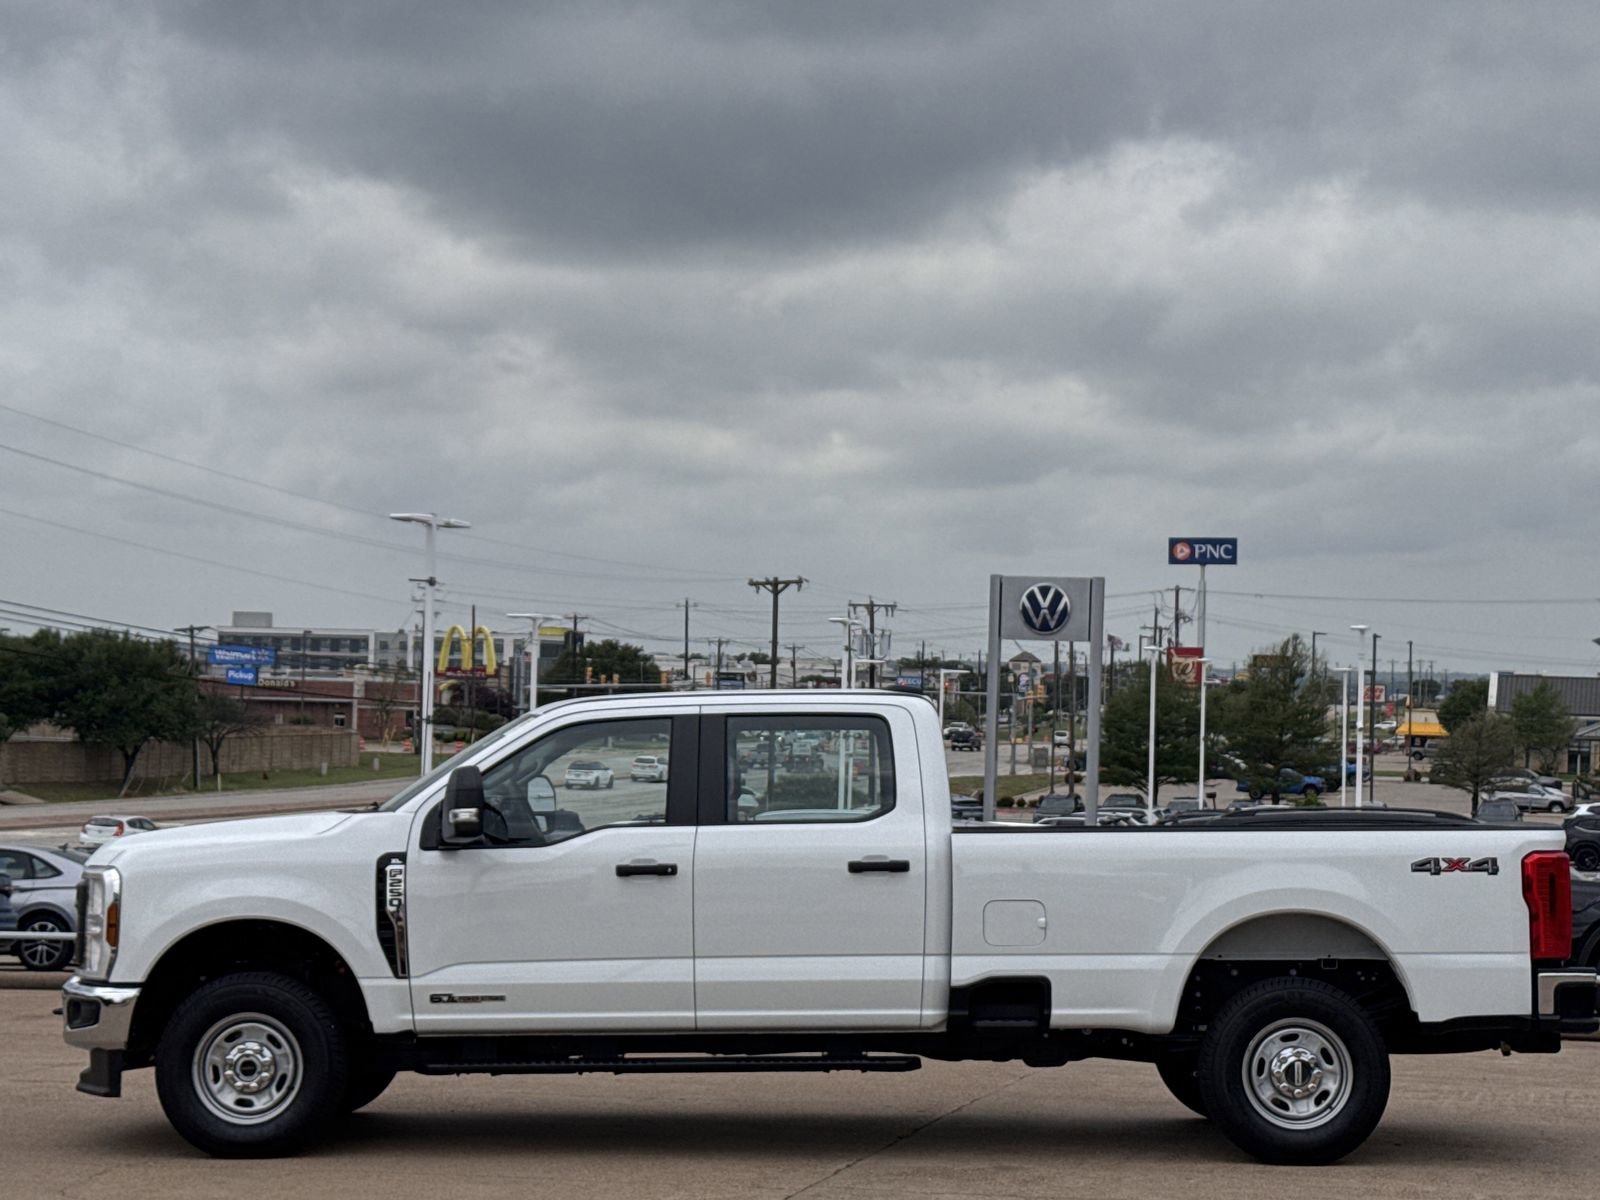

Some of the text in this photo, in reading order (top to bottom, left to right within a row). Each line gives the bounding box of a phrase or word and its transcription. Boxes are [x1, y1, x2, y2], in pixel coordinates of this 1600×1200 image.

[1194, 544, 1233, 559] PNC
[228, 670, 254, 680] Pickup
[258, 679, 295, 688] Donald's
